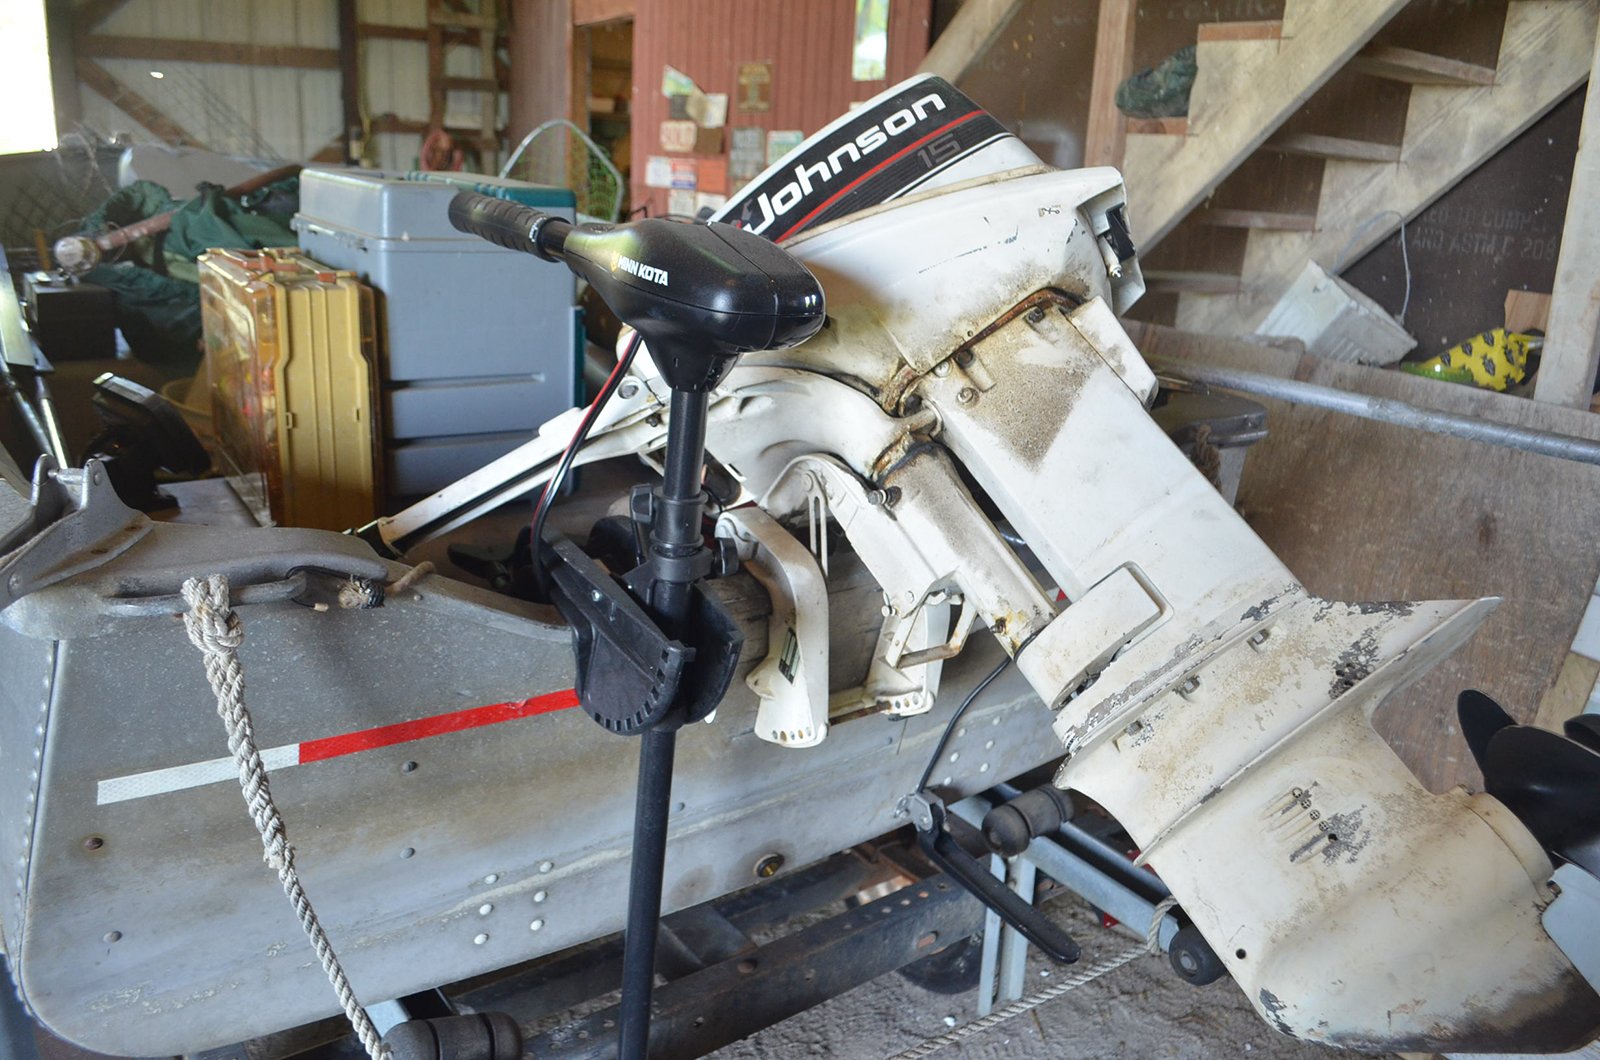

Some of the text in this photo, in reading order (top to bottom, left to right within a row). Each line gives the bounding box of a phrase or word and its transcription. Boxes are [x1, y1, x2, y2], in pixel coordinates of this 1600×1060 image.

[743, 93, 946, 236] Johnson
[917, 133, 960, 168] 15
[617, 254, 669, 287] MINN KOTA
